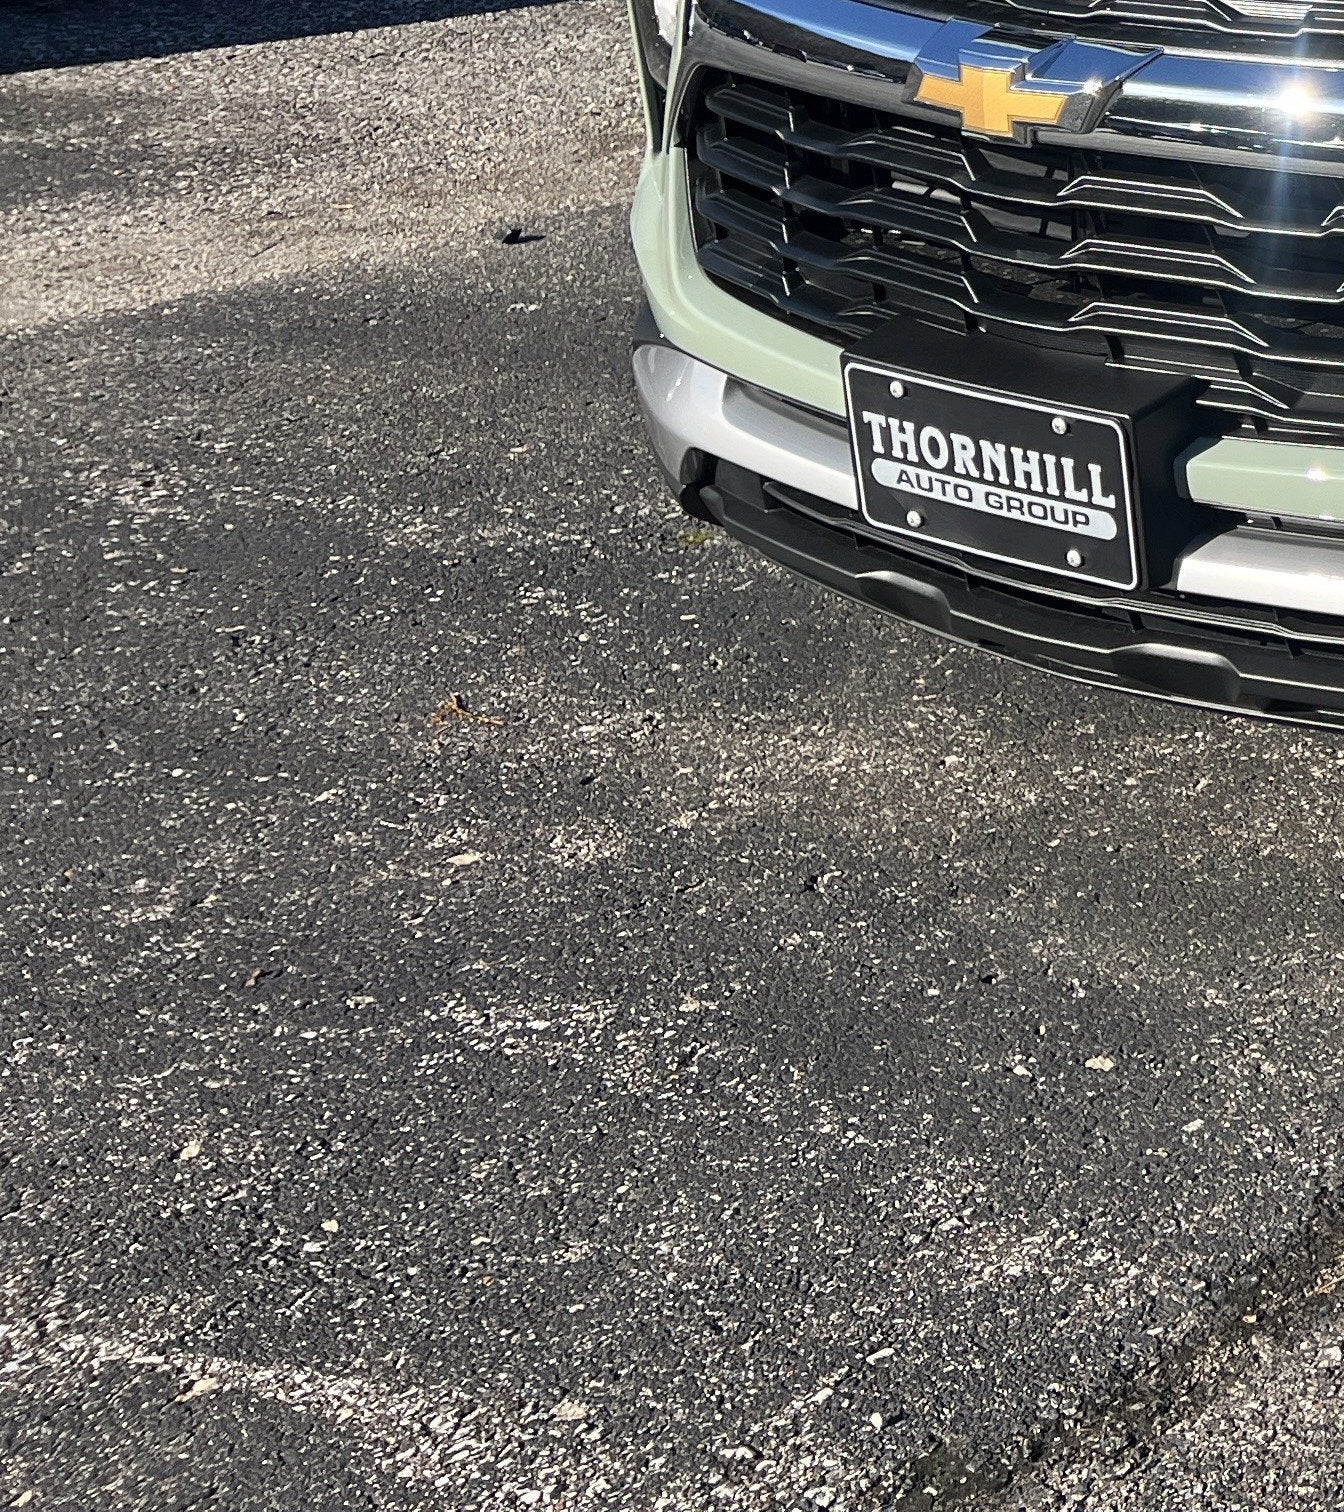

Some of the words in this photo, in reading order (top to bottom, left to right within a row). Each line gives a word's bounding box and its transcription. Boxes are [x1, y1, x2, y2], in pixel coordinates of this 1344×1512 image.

[862, 410, 1116, 509] THORNHILL
[896, 469, 973, 504] AUTO
[985, 491, 1090, 529] GROUP
